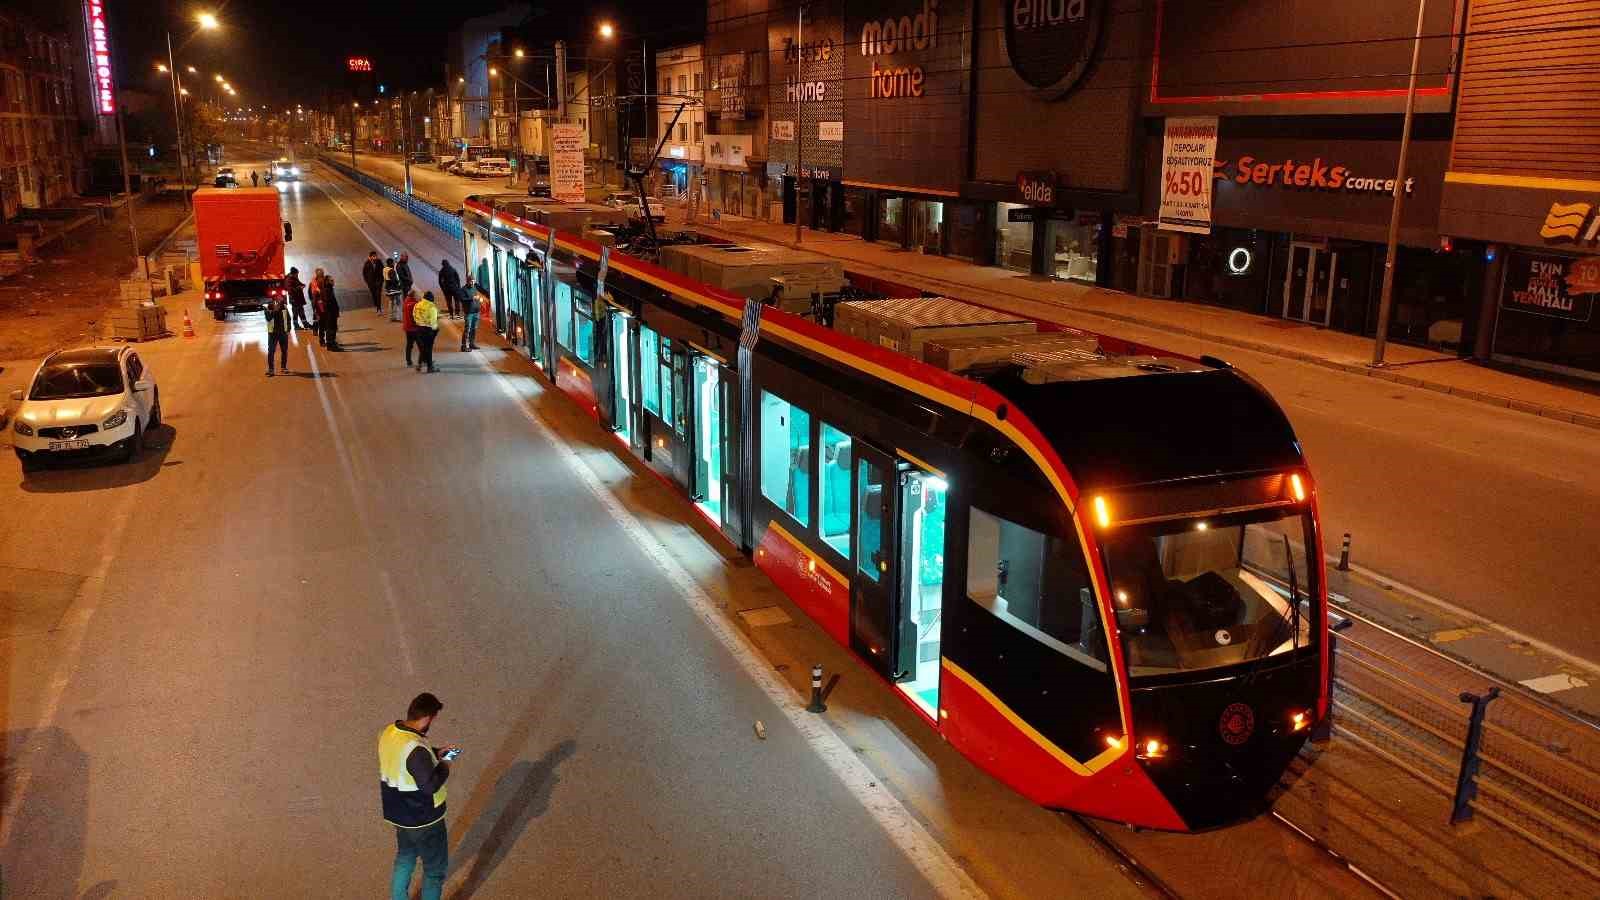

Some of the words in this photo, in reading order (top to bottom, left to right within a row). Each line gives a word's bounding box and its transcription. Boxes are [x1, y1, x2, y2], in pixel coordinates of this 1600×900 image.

[861, 0, 938, 56] mondi
[96, 55, 113, 112] HOTEL
[785, 77, 825, 102] Home
[871, 60, 923, 98] home
[1165, 170, 1203, 197] %50
[1235, 153, 1345, 188] Serteks
[1024, 180, 1053, 202] ellda
